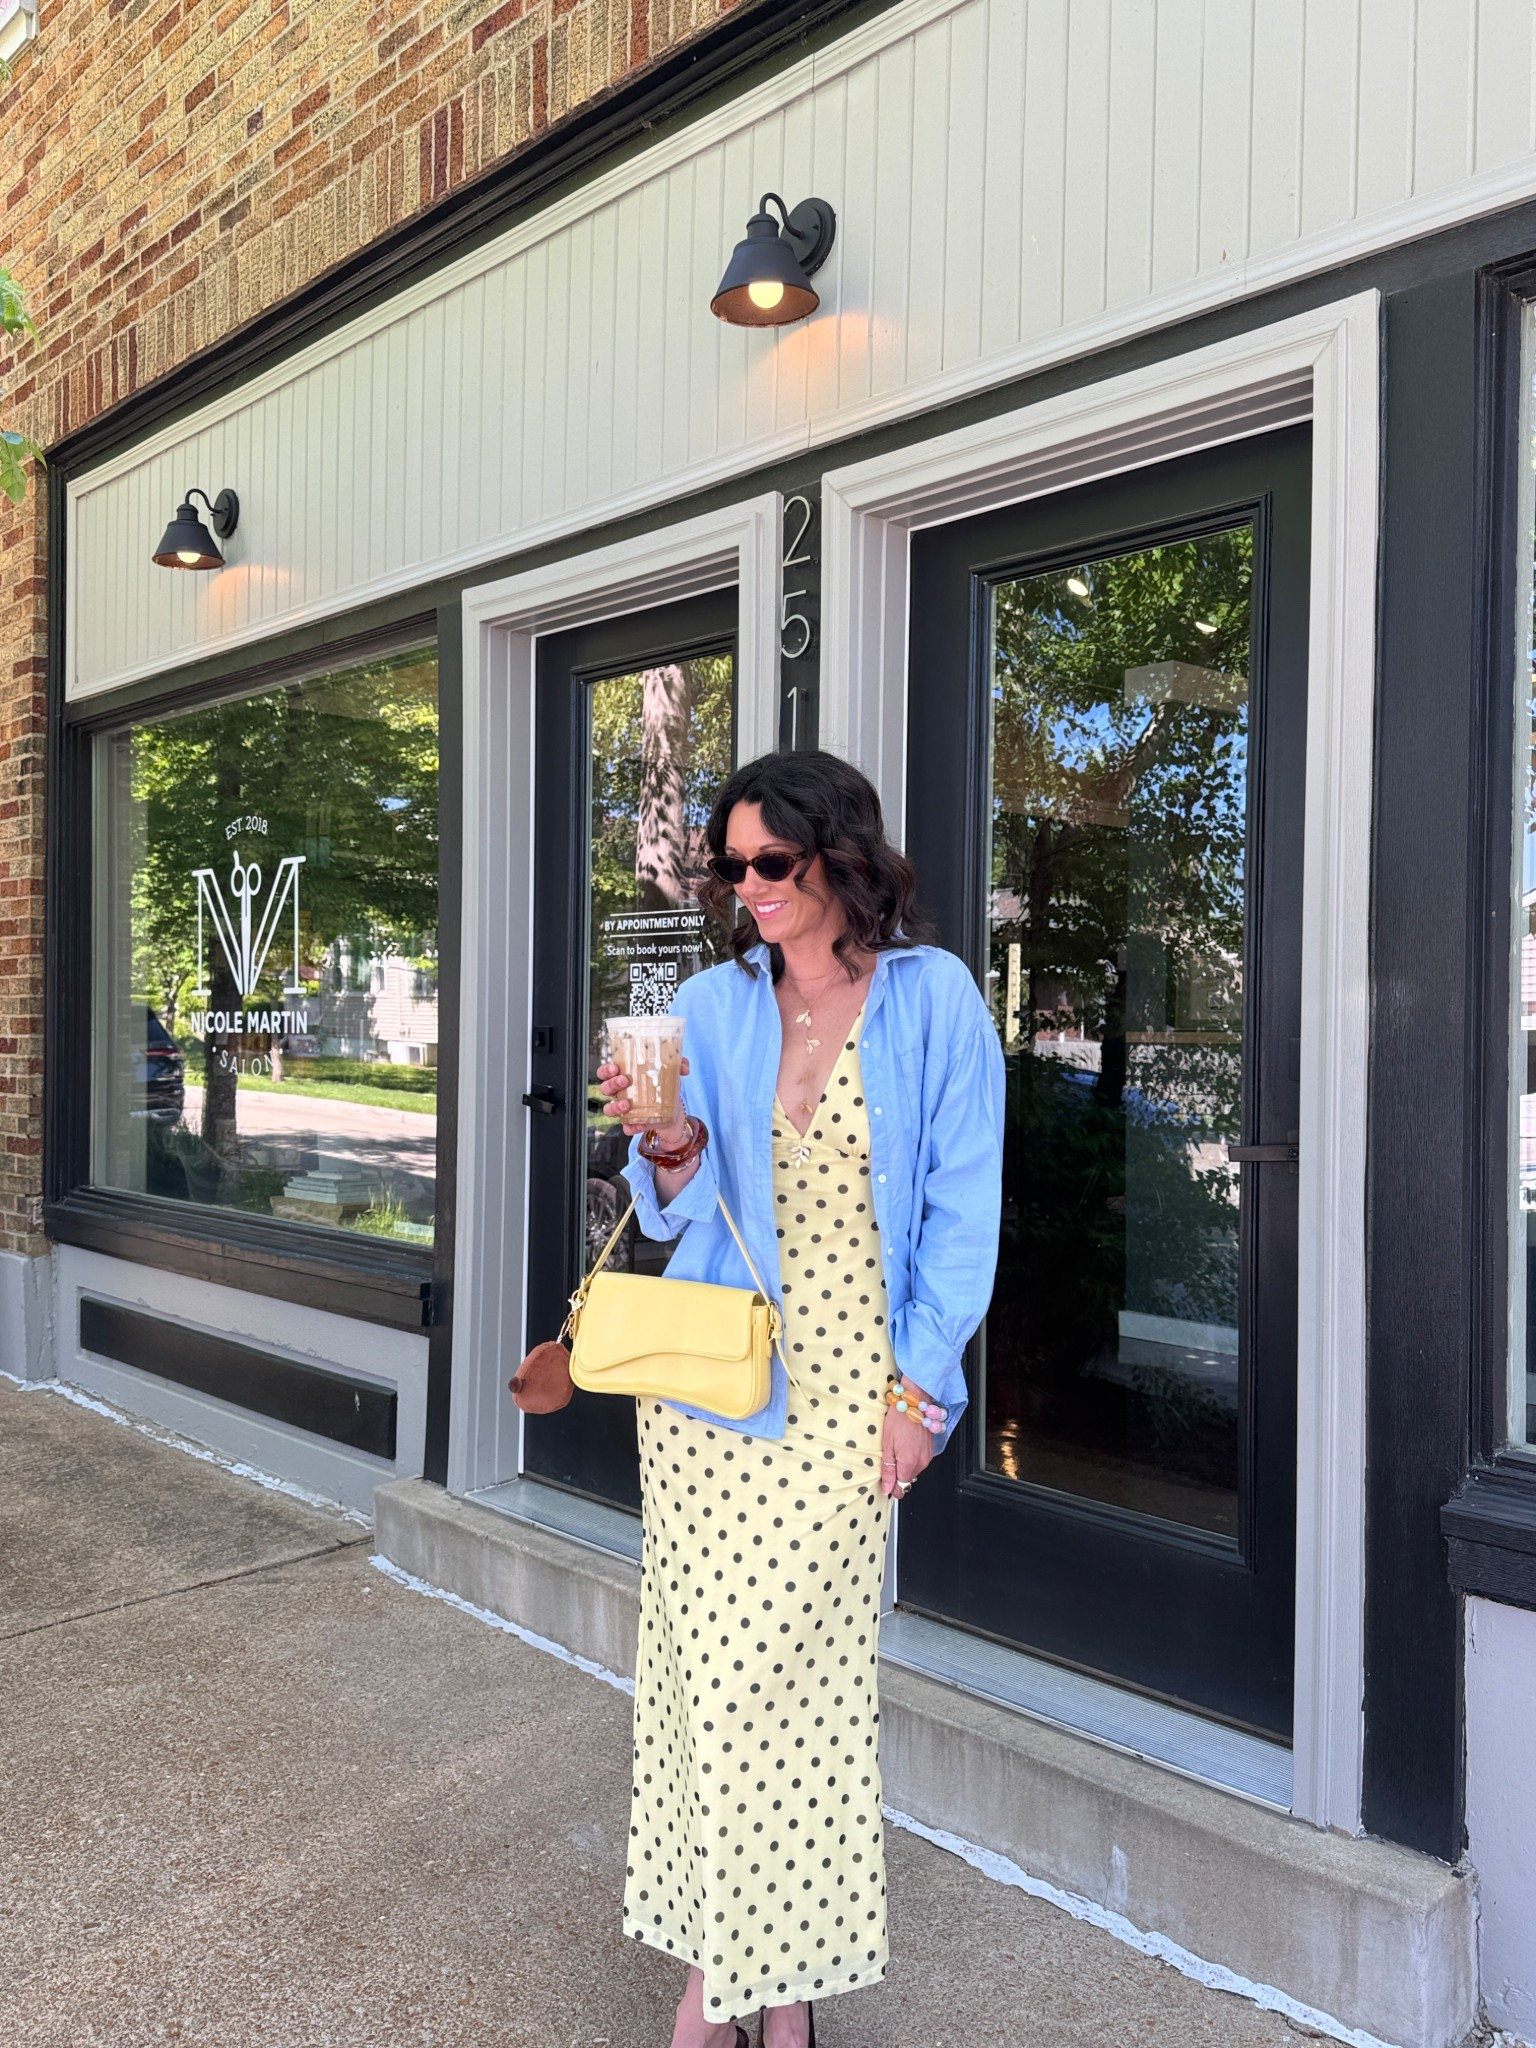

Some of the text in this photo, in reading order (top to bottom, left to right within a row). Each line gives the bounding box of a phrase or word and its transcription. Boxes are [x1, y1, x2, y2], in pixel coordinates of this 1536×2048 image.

[225, 815, 268, 841] EST. 2018
[604, 915, 706, 932] BY APPOINTMENT ONLY
[607, 941, 703, 957] Scan to book yours now!
[190, 1010, 308, 1034] NICOLE MARTIN
[219, 1049, 277, 1077] SALON
